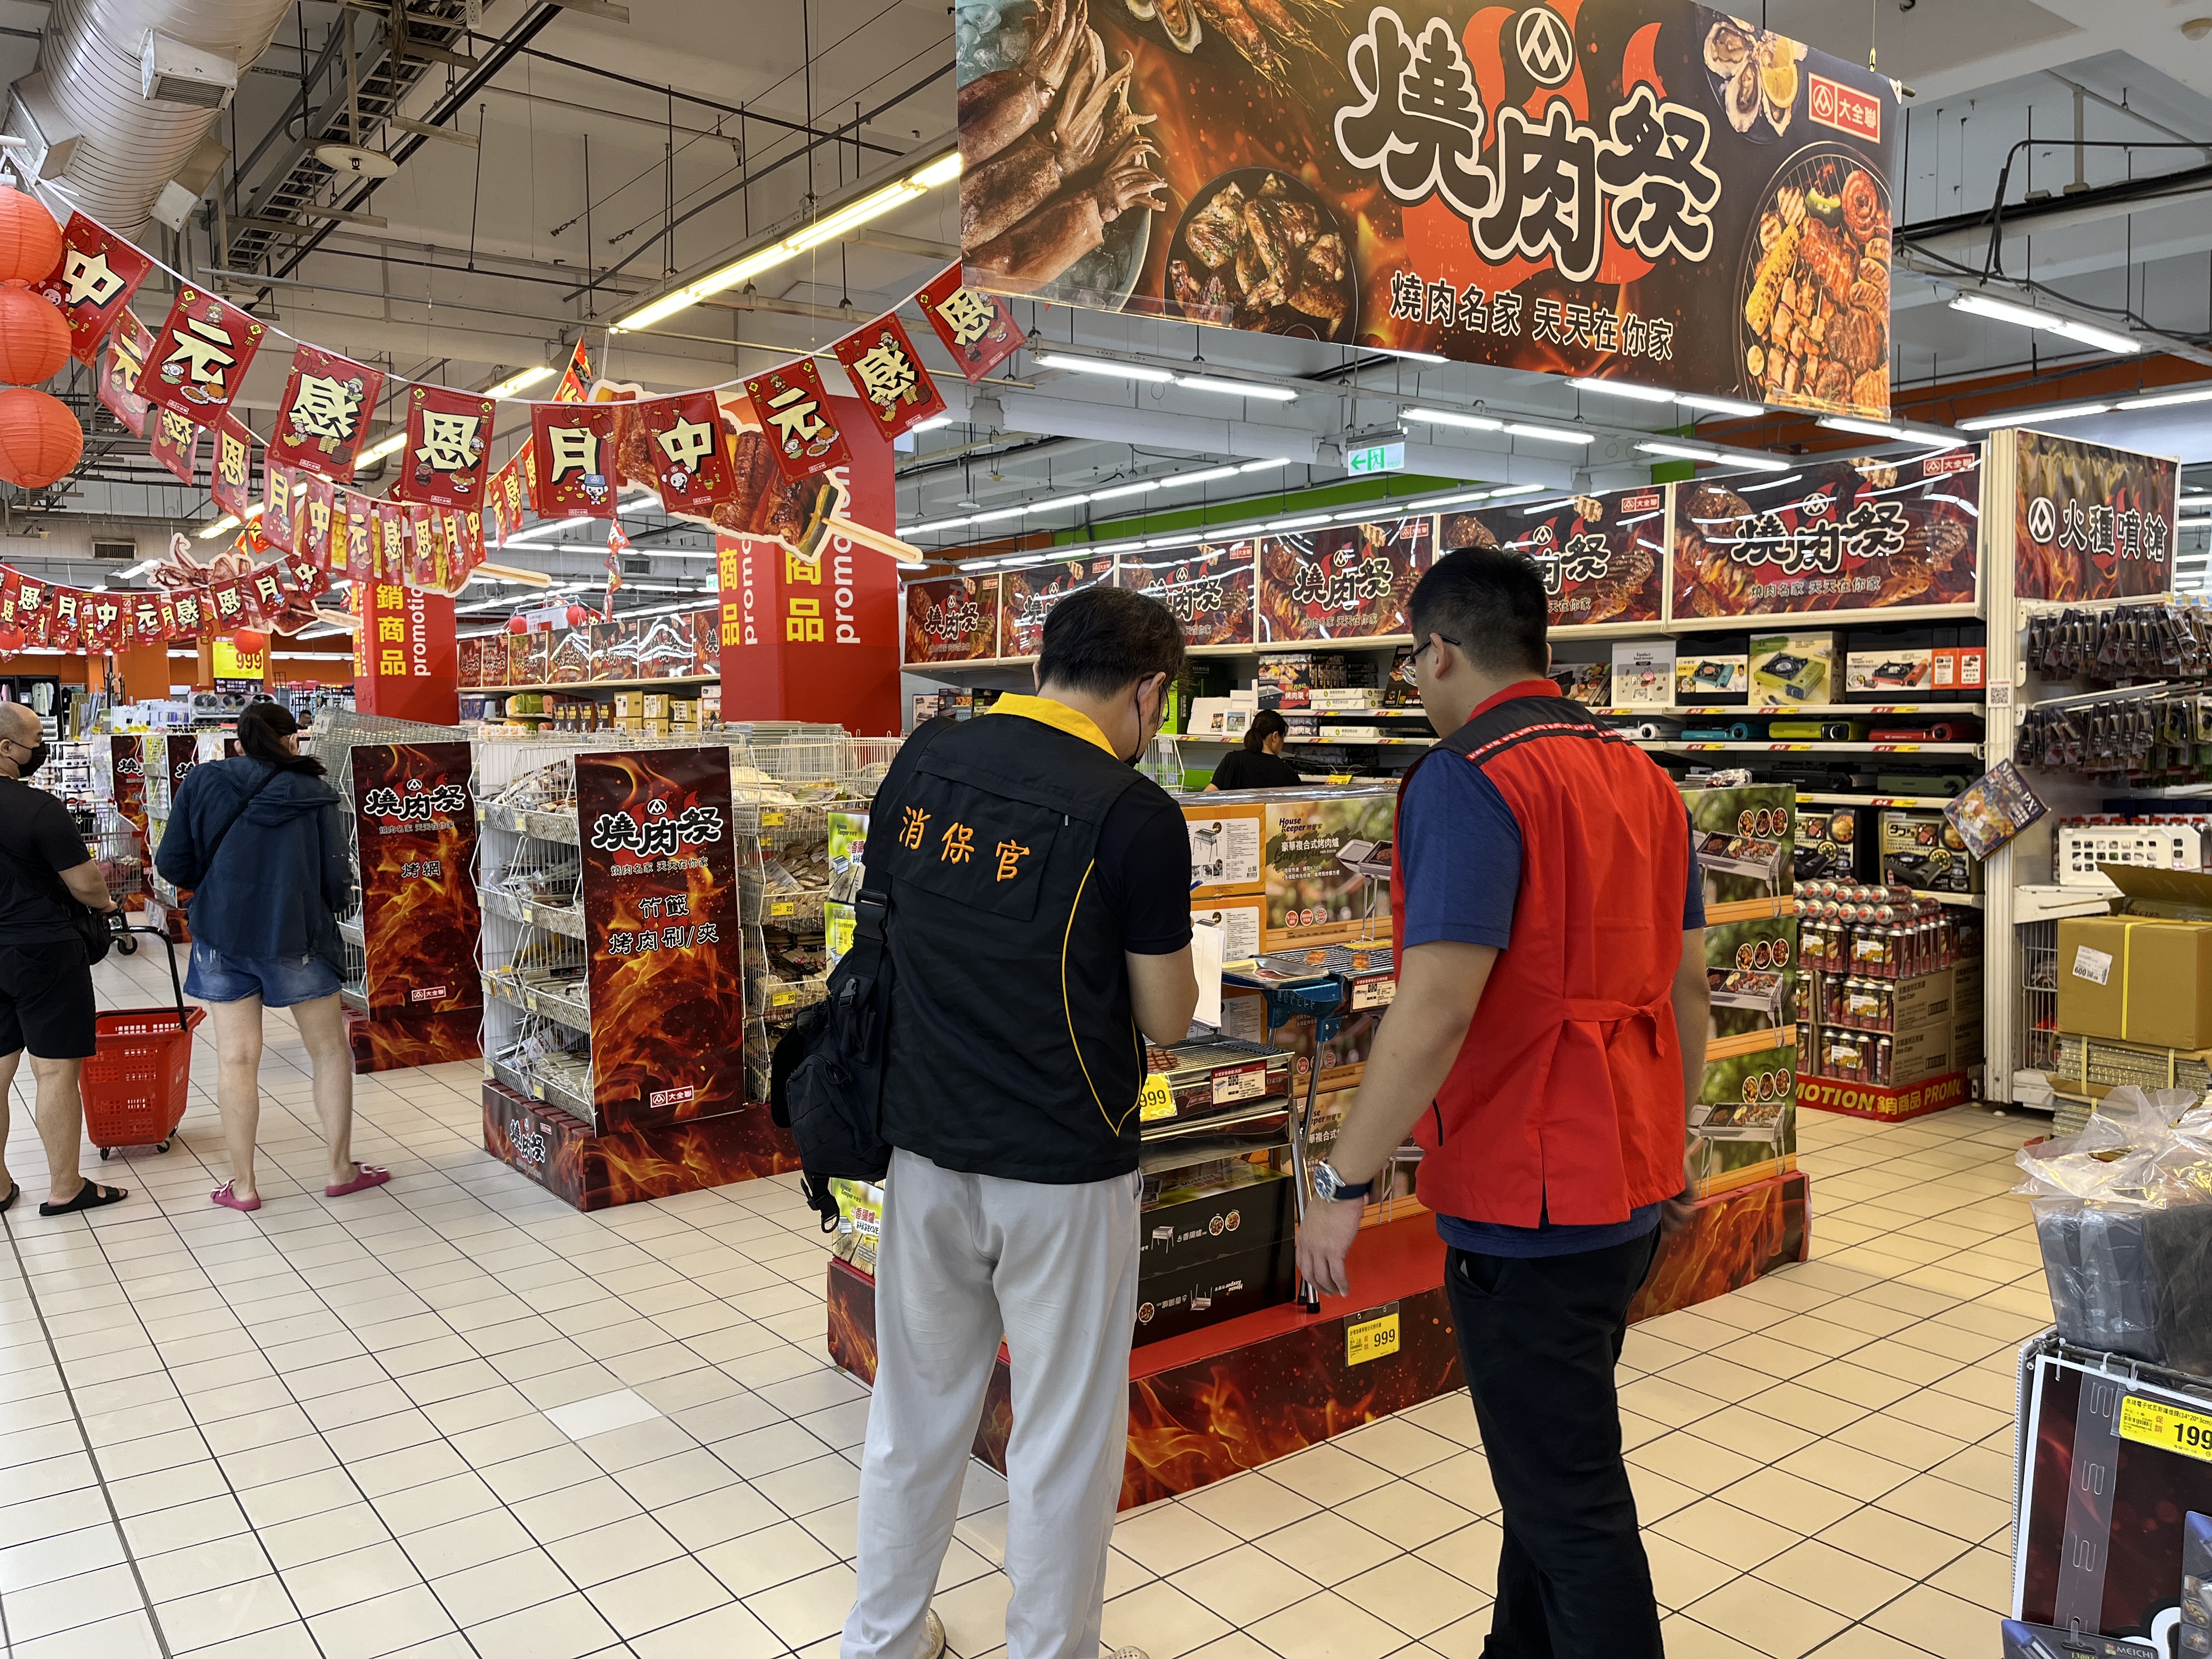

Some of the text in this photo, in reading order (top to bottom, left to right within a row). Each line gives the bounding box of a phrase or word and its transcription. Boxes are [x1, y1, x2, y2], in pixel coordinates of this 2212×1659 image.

[1838, 99, 1877, 129] 大全聯
[1334, 5, 1722, 283] 燒肉祭
[62, 250, 126, 306] 中
[935, 286, 995, 345] 恩
[1390, 271, 1674, 361] 燒肉名家 天天在你家
[162, 317, 236, 385] 元
[853, 341, 915, 402] 感
[289, 374, 360, 439] 感
[767, 388, 826, 450] 元
[415, 410, 479, 469] 恩
[548, 426, 597, 484] 月
[658, 417, 712, 473] 中
[218, 431, 245, 485] 恩
[269, 467, 290, 517] 月
[1635, 497, 1658, 510] 大全聯
[309, 496, 330, 540] 中
[349, 514, 368, 555] 元
[443, 516, 459, 548] 月
[467, 512, 480, 541] 中
[2058, 498, 2168, 562] 火種噴槍
[415, 519, 432, 560] 恩
[833, 466, 861, 644] promon
[1731, 501, 1909, 575] 燒肉祭
[18, 585, 41, 611] 恩
[217, 587, 241, 616] 恩
[255, 575, 279, 603] 月
[719, 548, 740, 646] 商品
[785, 551, 825, 642] 商品
[1293, 557, 1392, 611] 燒肉祭
[1751, 575, 1882, 600] 燒肉名家 天天在你家
[58, 595, 77, 619] 月
[96, 601, 118, 627] 中
[136, 603, 159, 628] 元
[924, 601, 979, 641] 燒肉祭
[1336, 612, 1378, 627] 天天在你家
[1548, 597, 1592, 613] 天在你家
[376, 583, 407, 676] 銷商品
[236, 652, 262, 669] 999
[364, 785, 465, 821] 燒肉祭
[379, 821, 455, 834] 燒肉名家 天天在你家
[591, 806, 723, 857] 燒肉祭
[1279, 817, 1301, 826] House
[1282, 825, 1306, 833] Keeper
[899, 805, 1030, 882] 消保官
[1281, 837, 1340, 852] 豪華複合式烤肉爐
[401, 860, 441, 878] 烤網
[611, 856, 708, 877] 燒肉名家 天天在你家
[669, 1090, 692, 1101] 大全聯
[1139, 1090, 1167, 1108] 999
[1877, 1091, 1921, 1115] 銷商品
[510, 1119, 545, 1164] 燒肉祭
[856, 1207, 876, 1224] 香腸爐
[1374, 1329, 1396, 1347] 999
[2174, 1423, 2212, 1450] 199
[2117, 1646, 2154, 1659] MEICHI
